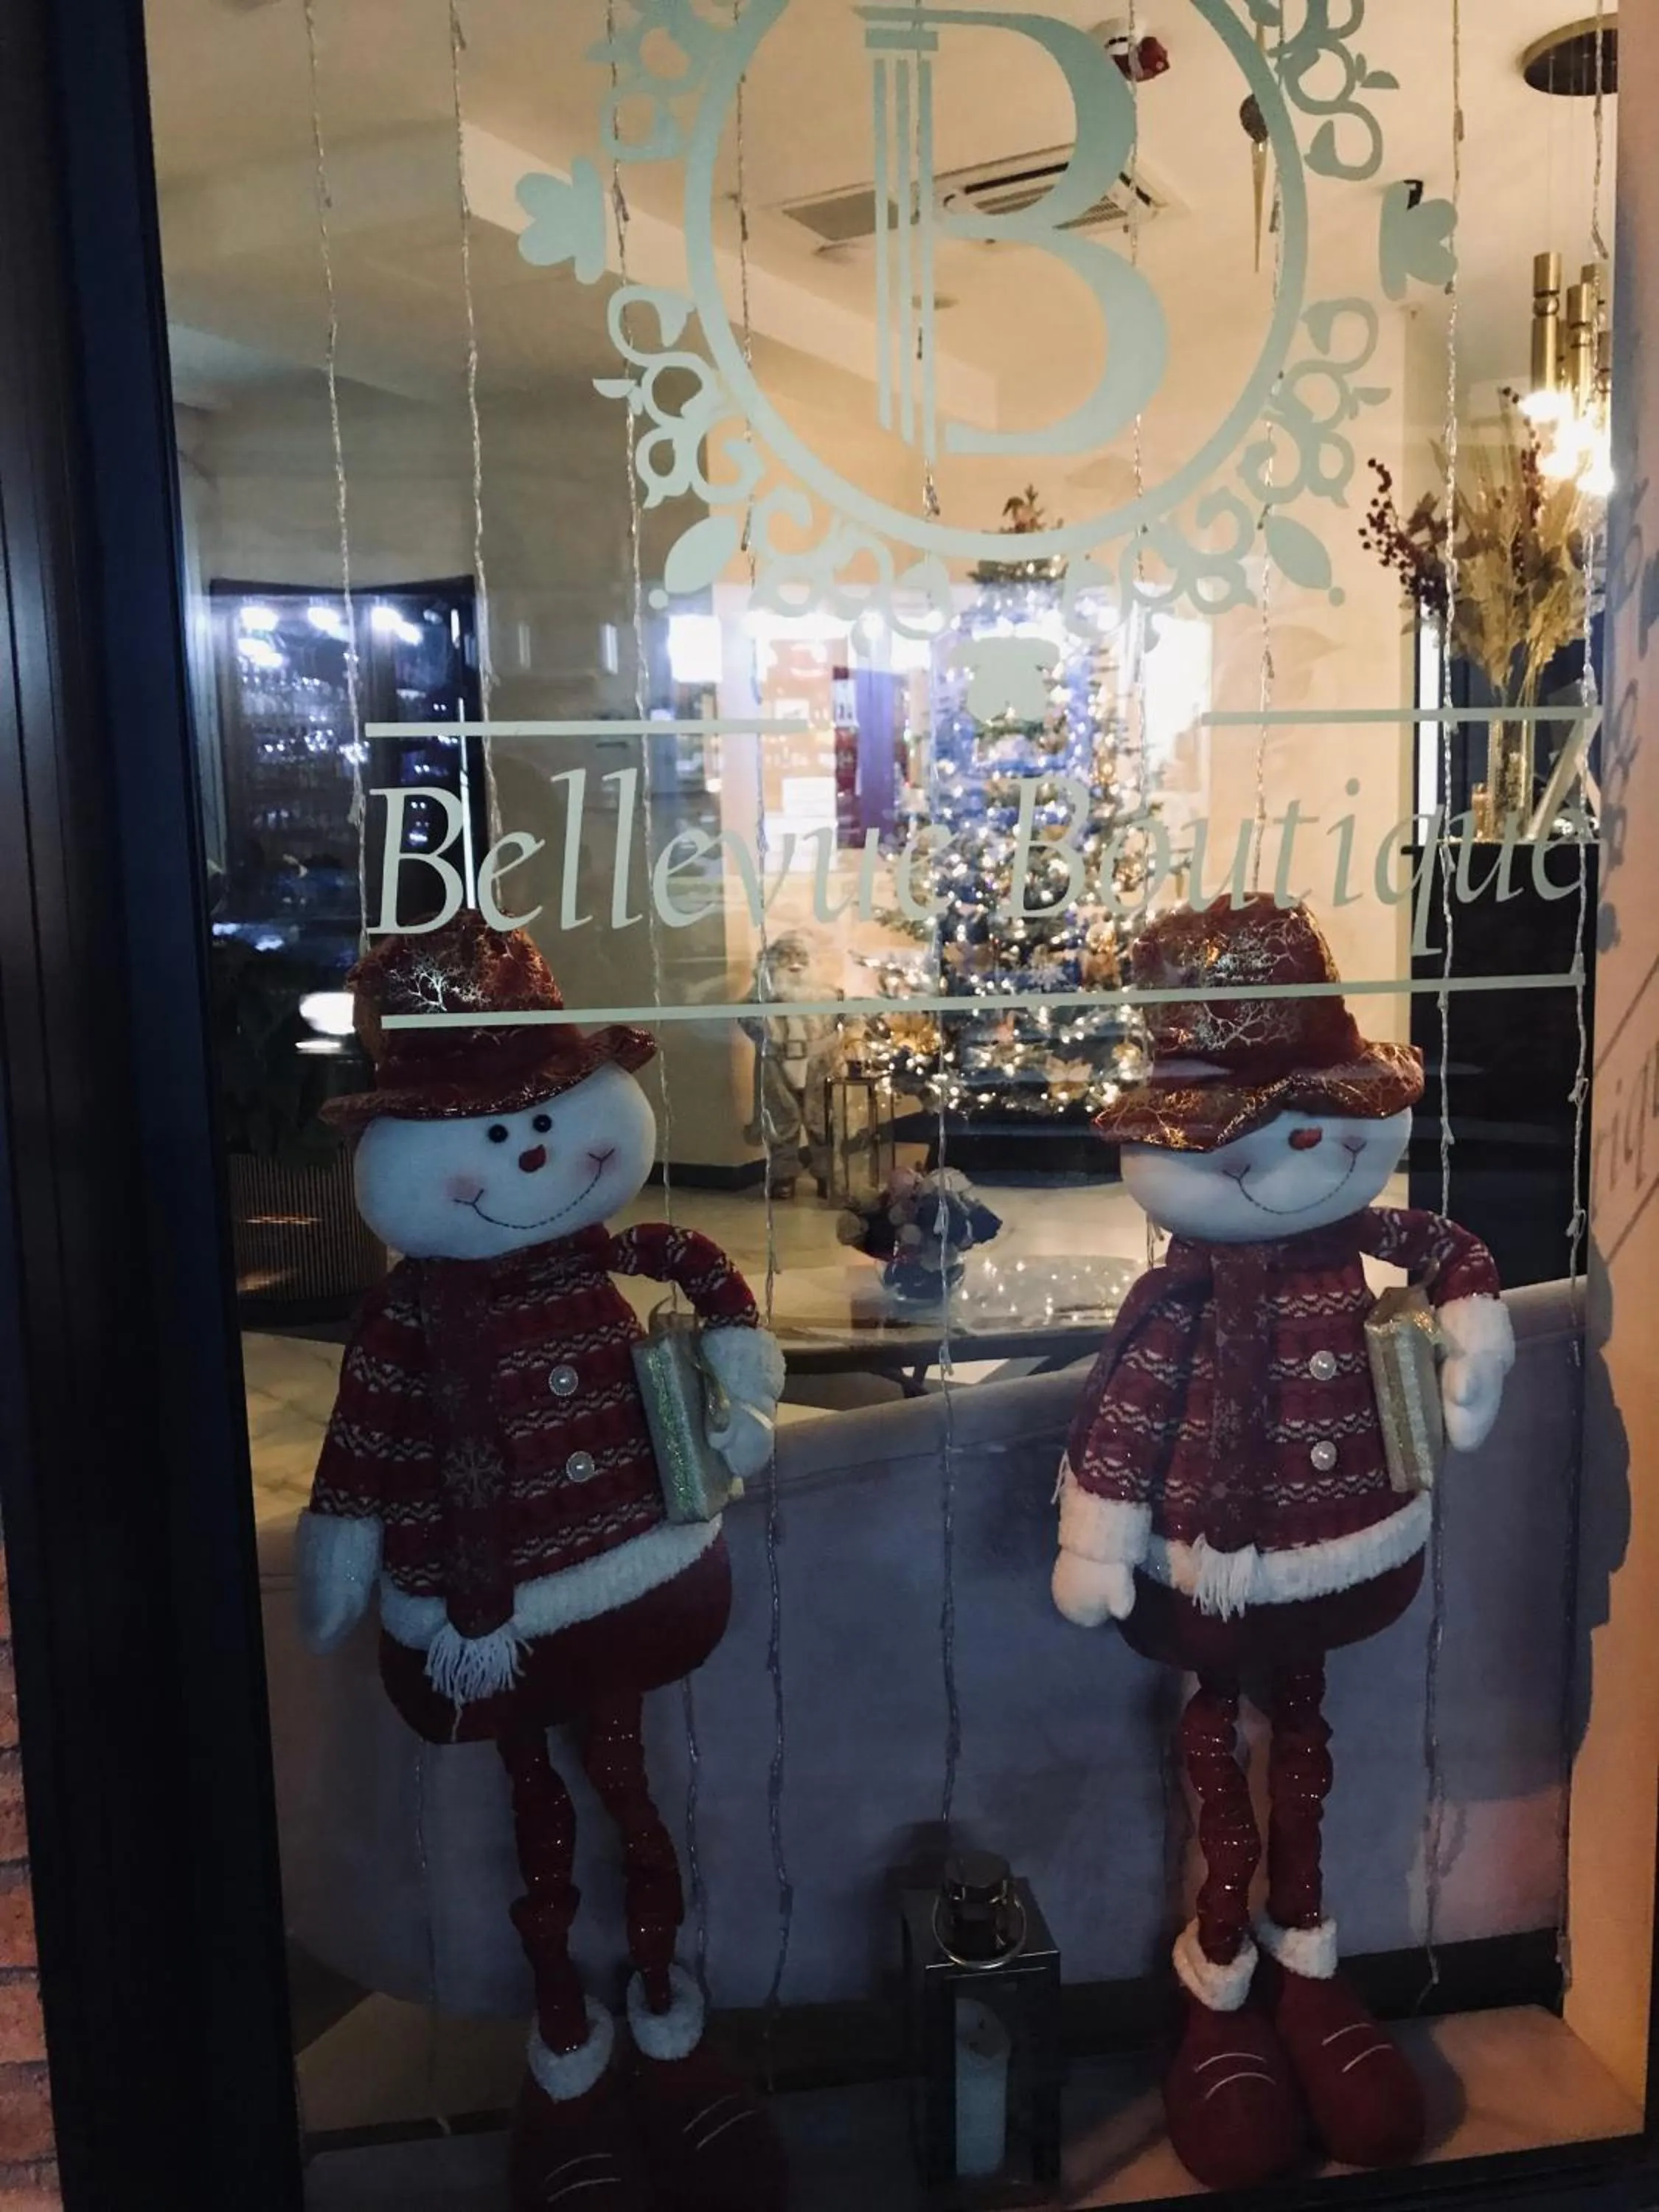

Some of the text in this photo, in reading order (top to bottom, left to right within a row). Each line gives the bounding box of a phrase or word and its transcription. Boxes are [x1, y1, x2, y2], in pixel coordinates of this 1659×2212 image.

[853, 5, 1169, 462] B
[366, 768, 1593, 956] Bellevue Boutique
